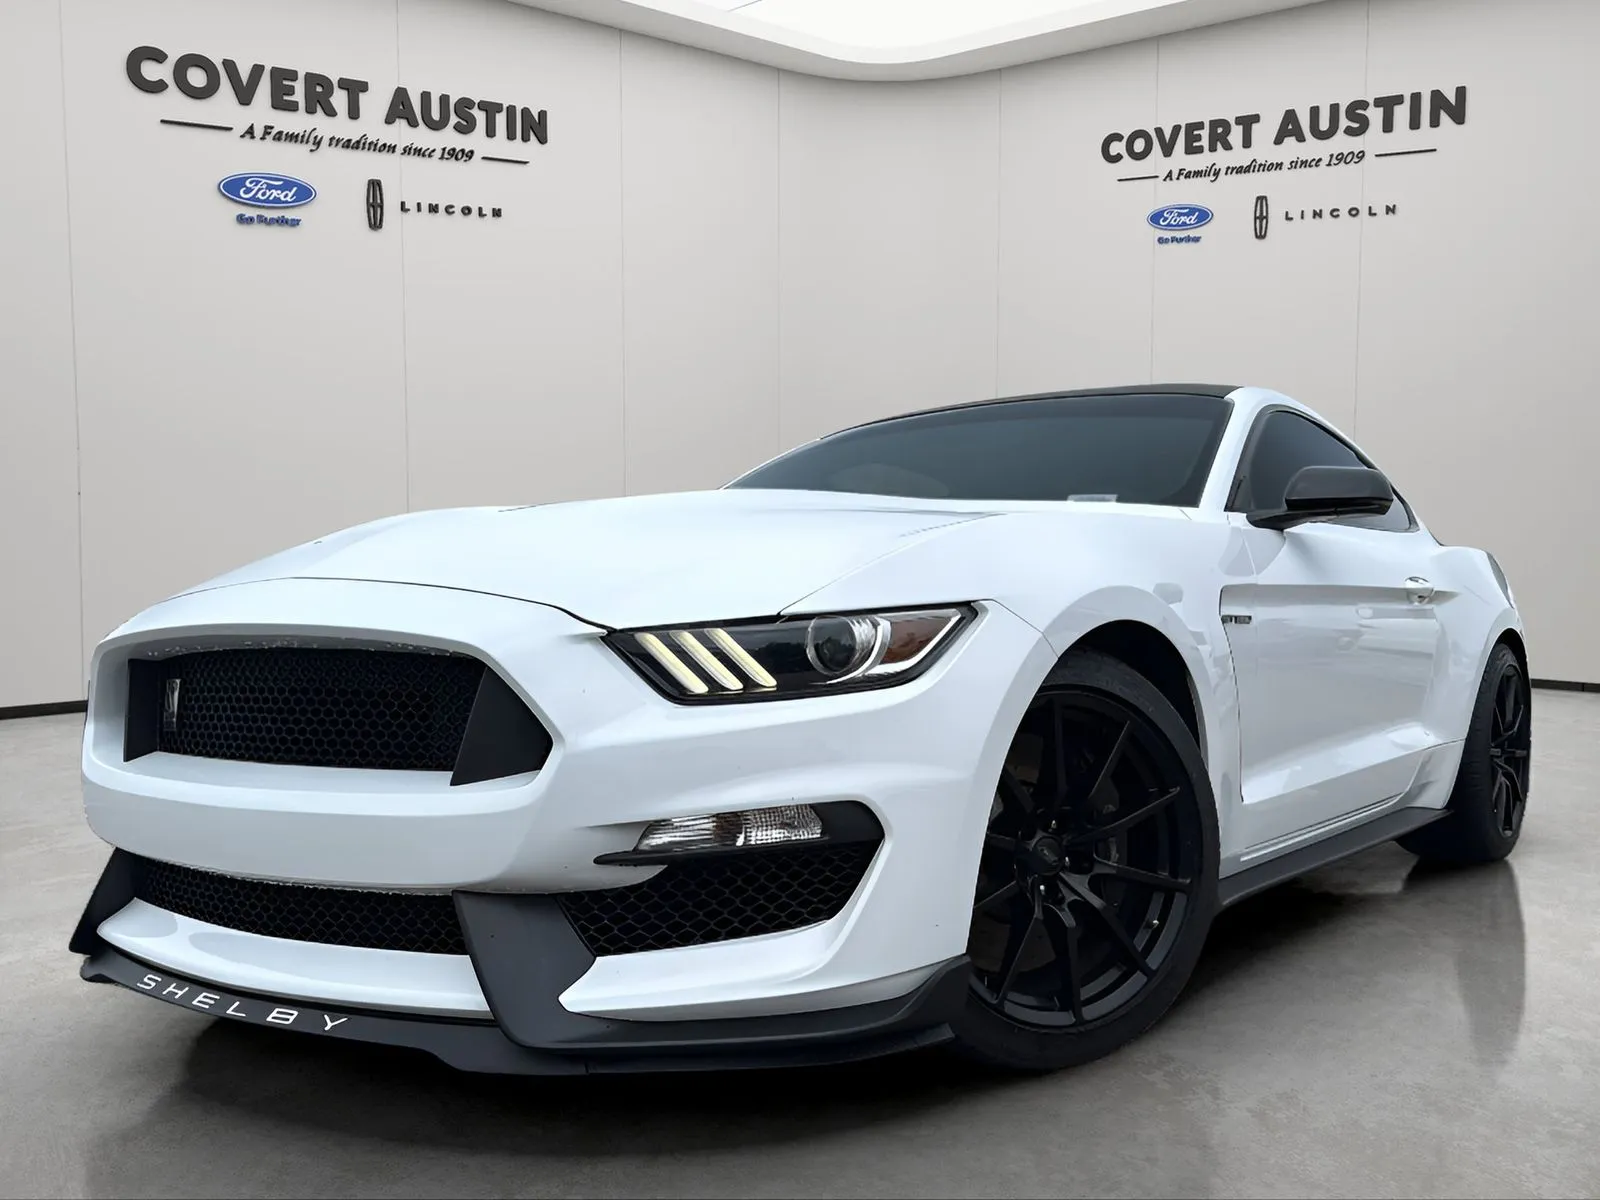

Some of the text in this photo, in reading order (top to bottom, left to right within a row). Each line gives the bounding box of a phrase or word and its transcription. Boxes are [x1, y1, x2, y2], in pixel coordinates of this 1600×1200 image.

[125, 45, 549, 145] COVERT AUSTIN
[1100, 85, 1467, 164] COVERT AUSTIN
[240, 122, 475, 162] A Family tradition since 1909
[1162, 150, 1366, 183] A Family tradition since 1909
[239, 177, 298, 202] Ford
[236, 213, 255, 225] Go
[400, 200, 503, 219] LINCOLN
[1159, 208, 1199, 225] Ford
[1284, 203, 1398, 221] LINCOLN
[1157, 236, 1170, 245] Go
[136, 973, 349, 1031] SHELBY
